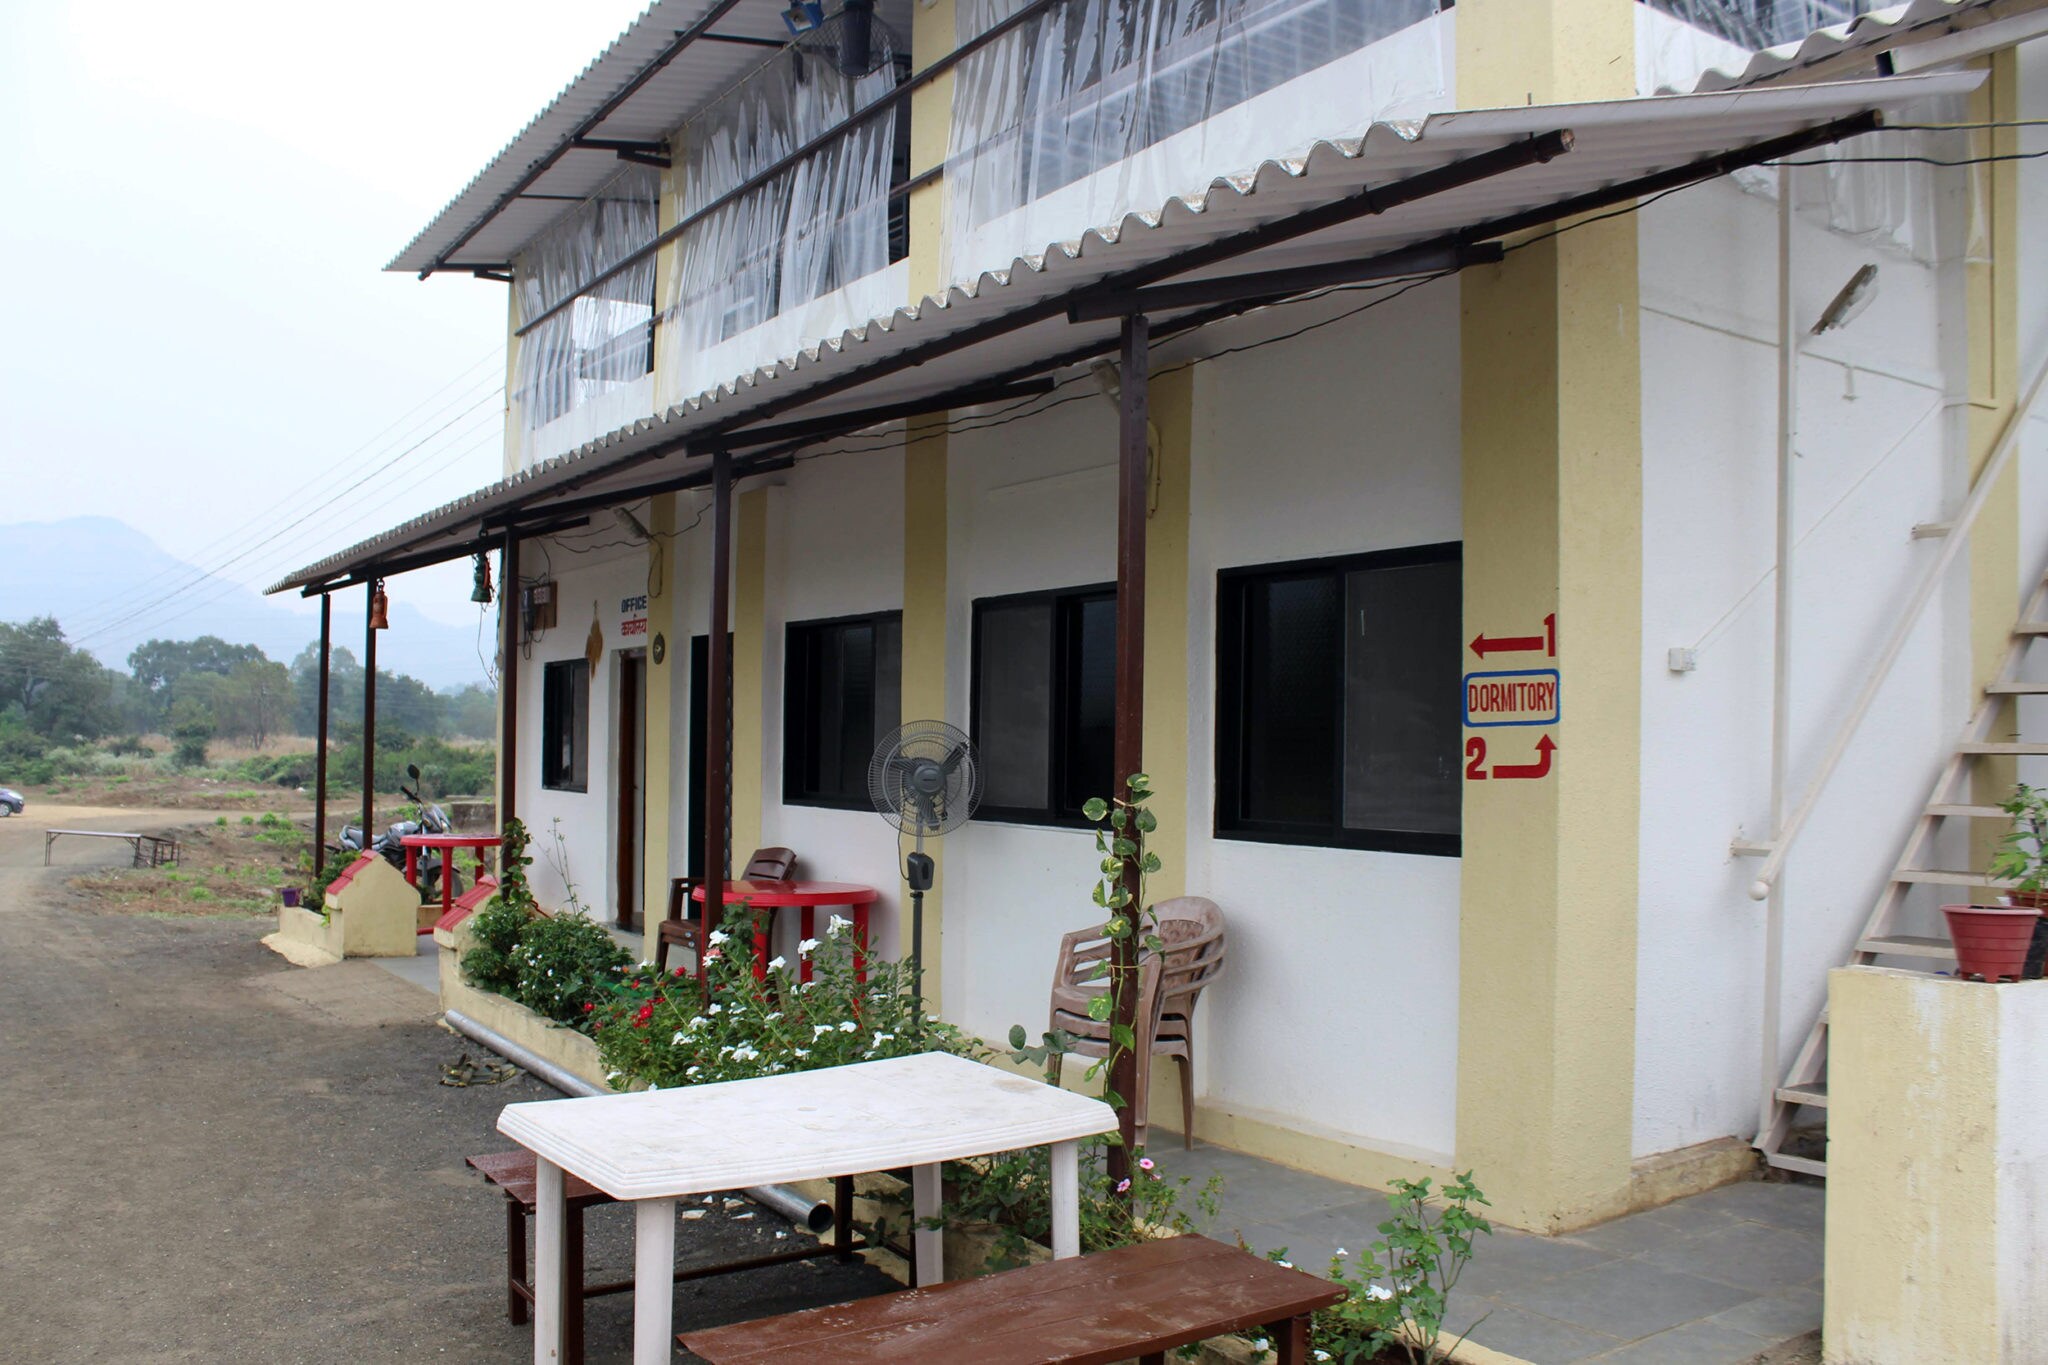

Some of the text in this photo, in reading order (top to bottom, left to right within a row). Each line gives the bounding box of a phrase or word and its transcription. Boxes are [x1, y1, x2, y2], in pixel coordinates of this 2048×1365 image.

[621, 595, 648, 613] OFFICE
[1543, 613, 1556, 657] 1
[1468, 682, 1555, 712] DORMITORY
[1465, 736, 1487, 780] 2
